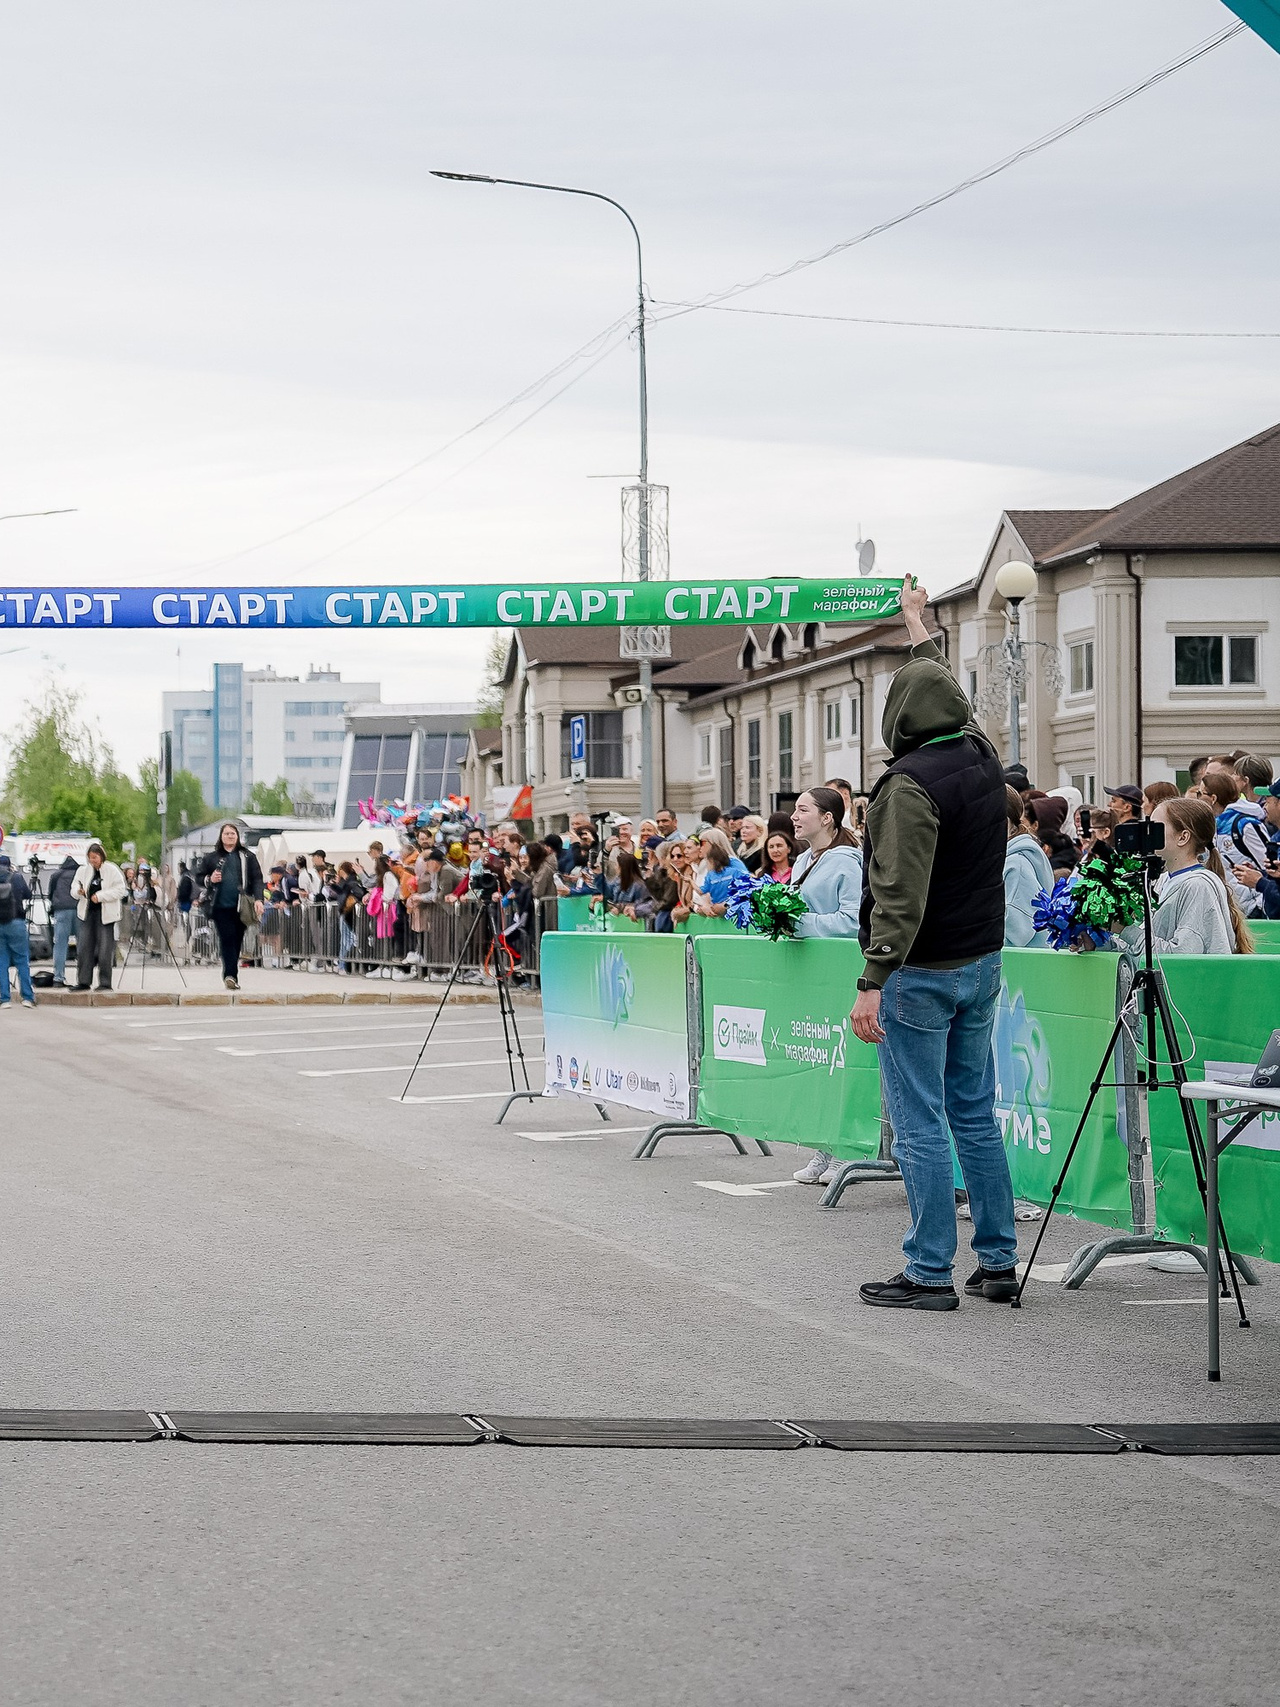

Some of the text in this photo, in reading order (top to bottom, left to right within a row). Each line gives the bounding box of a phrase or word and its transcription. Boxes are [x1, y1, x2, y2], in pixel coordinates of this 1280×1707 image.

[822, 584, 885, 598] зелёный
[152, 593, 294, 625] СТАРТ
[325, 591, 465, 624] СТАРТ
[496, 589, 634, 623] СТАРТ
[664, 585, 799, 620] СТАРТ
[813, 599, 878, 612] марафон
[790, 1015, 831, 1040] зелёный
[785, 1041, 829, 1068] марафон
